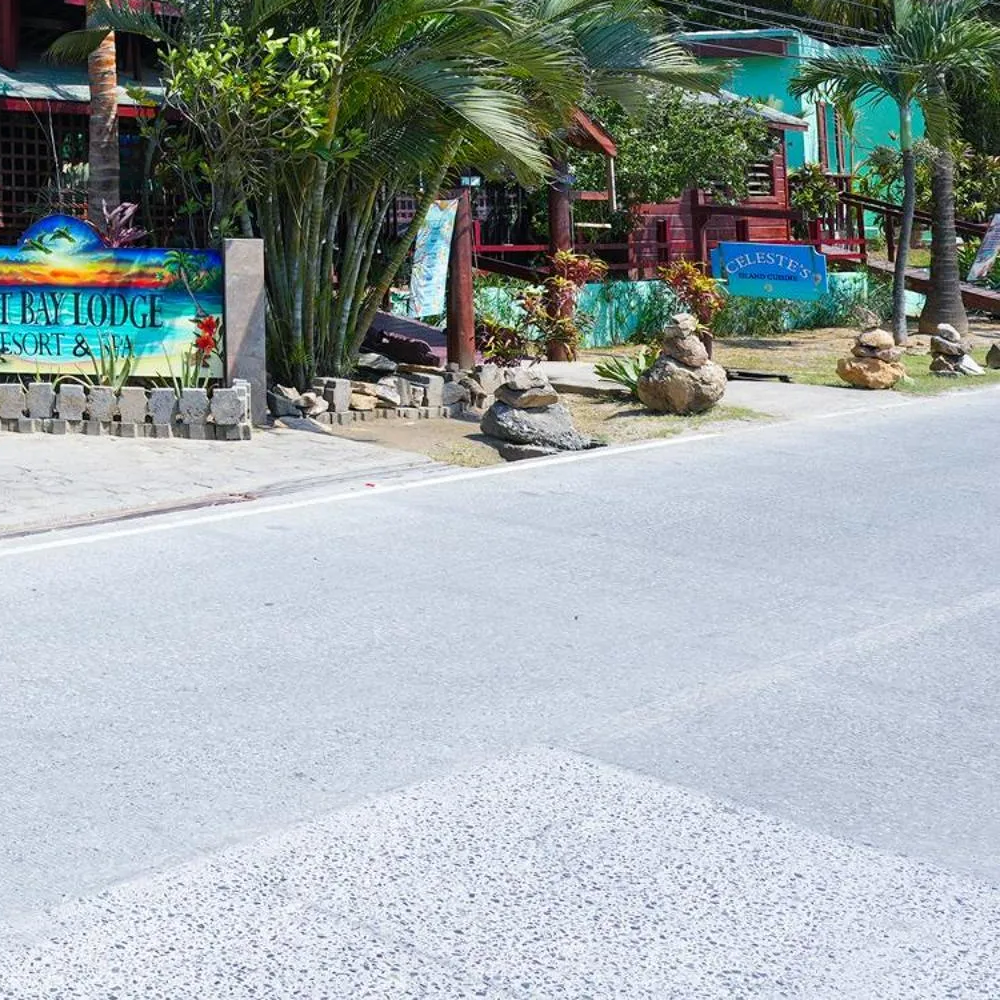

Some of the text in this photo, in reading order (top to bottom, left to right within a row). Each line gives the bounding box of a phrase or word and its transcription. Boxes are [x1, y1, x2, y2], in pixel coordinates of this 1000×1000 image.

[726, 252, 811, 278] CELESTE'S
[20, 290, 66, 326] BAY
[73, 291, 164, 329] LODGE
[72, 333, 92, 357] &
